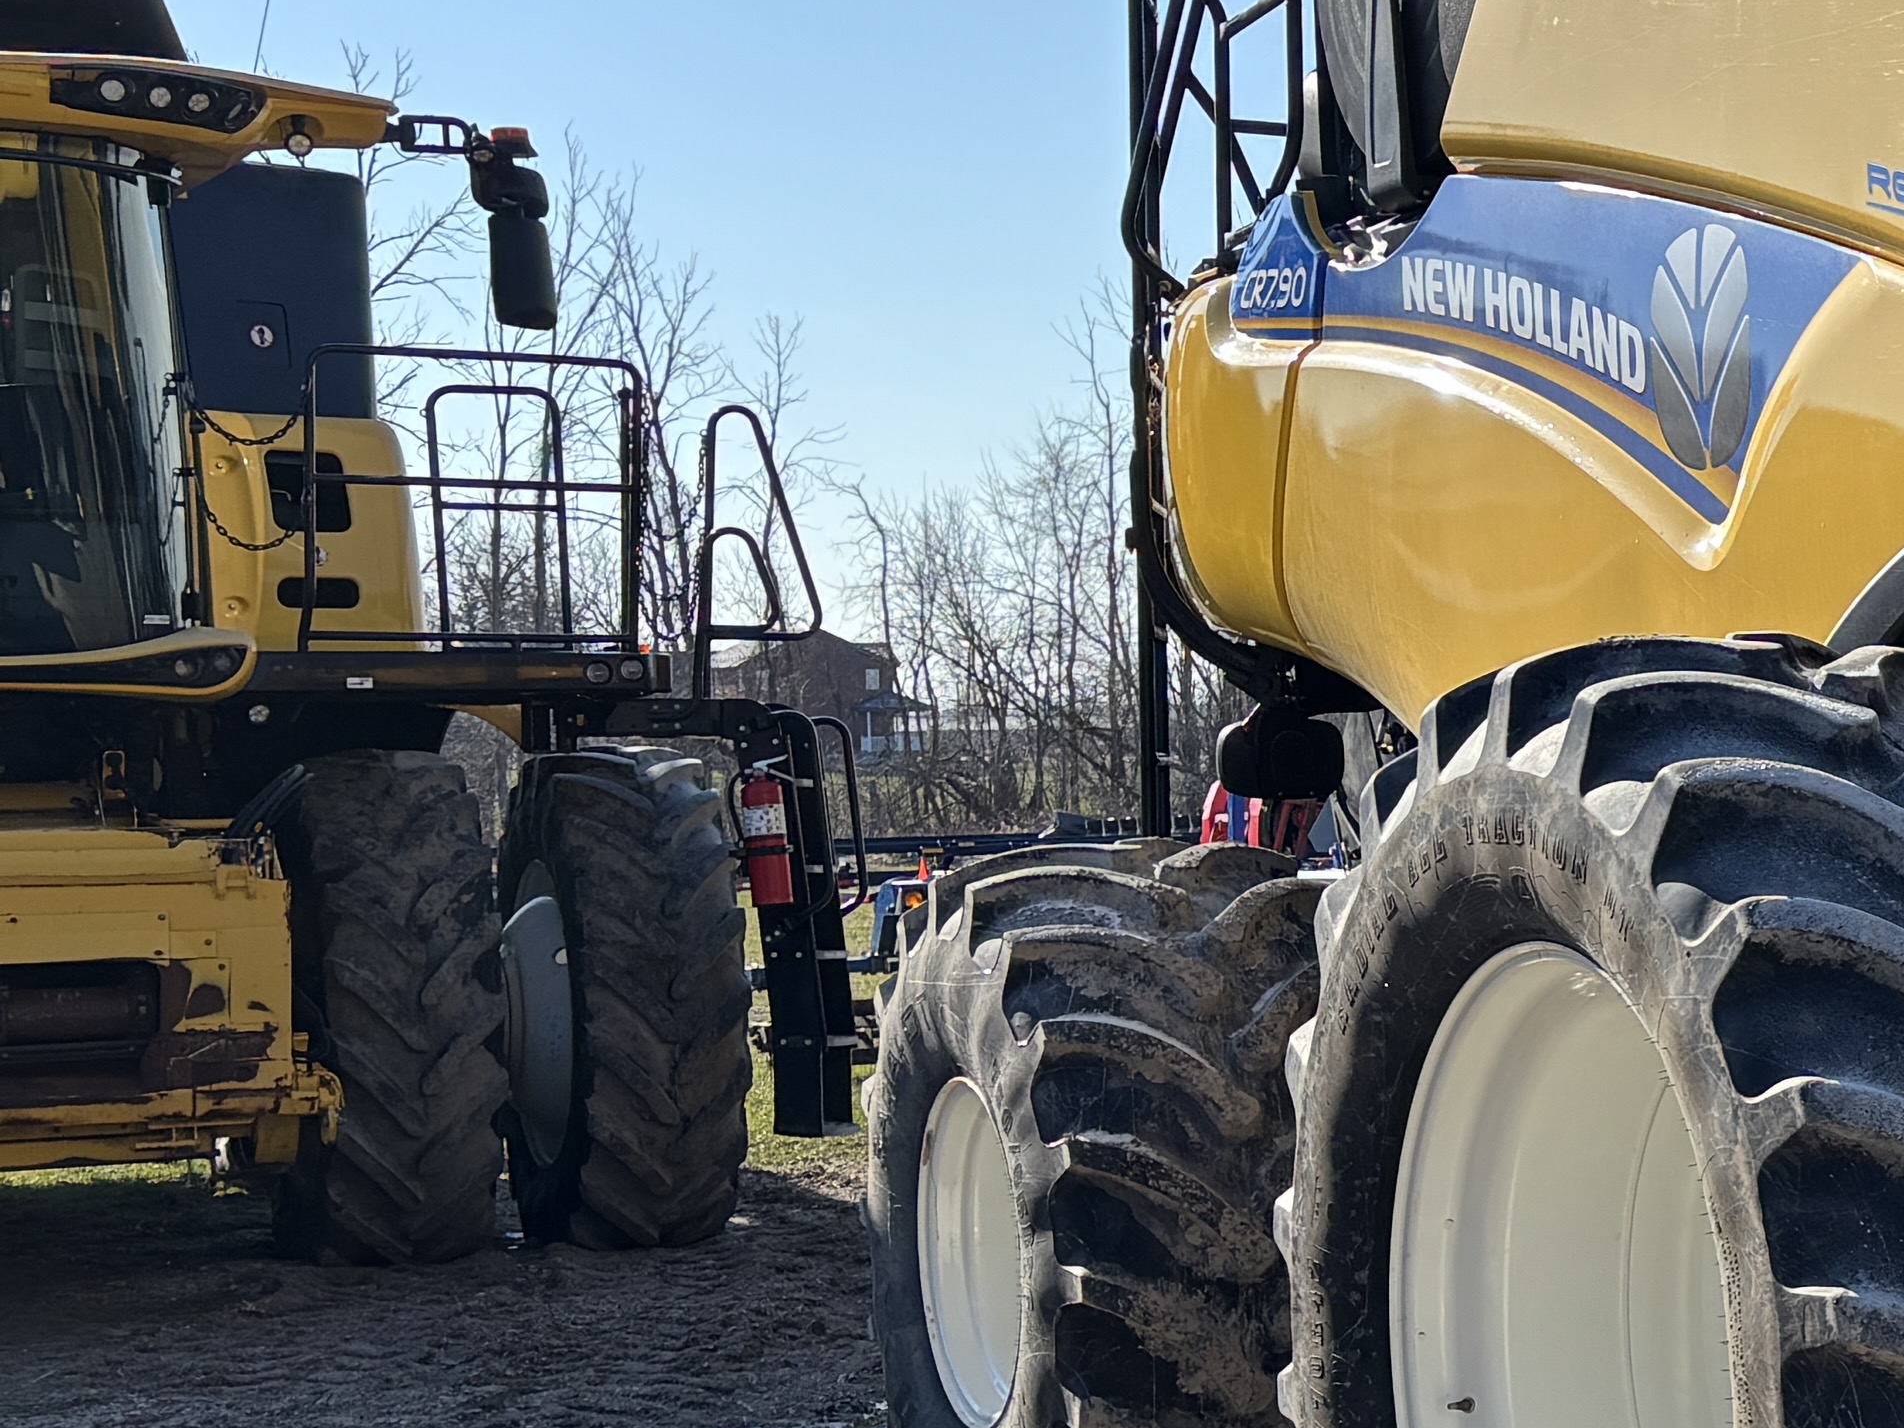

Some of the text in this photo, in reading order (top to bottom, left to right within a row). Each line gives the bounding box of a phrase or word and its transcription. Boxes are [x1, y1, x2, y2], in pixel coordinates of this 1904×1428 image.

[1239, 264, 1308, 311] CR7.90
[1400, 254, 1648, 396] NEW HOLLAND
